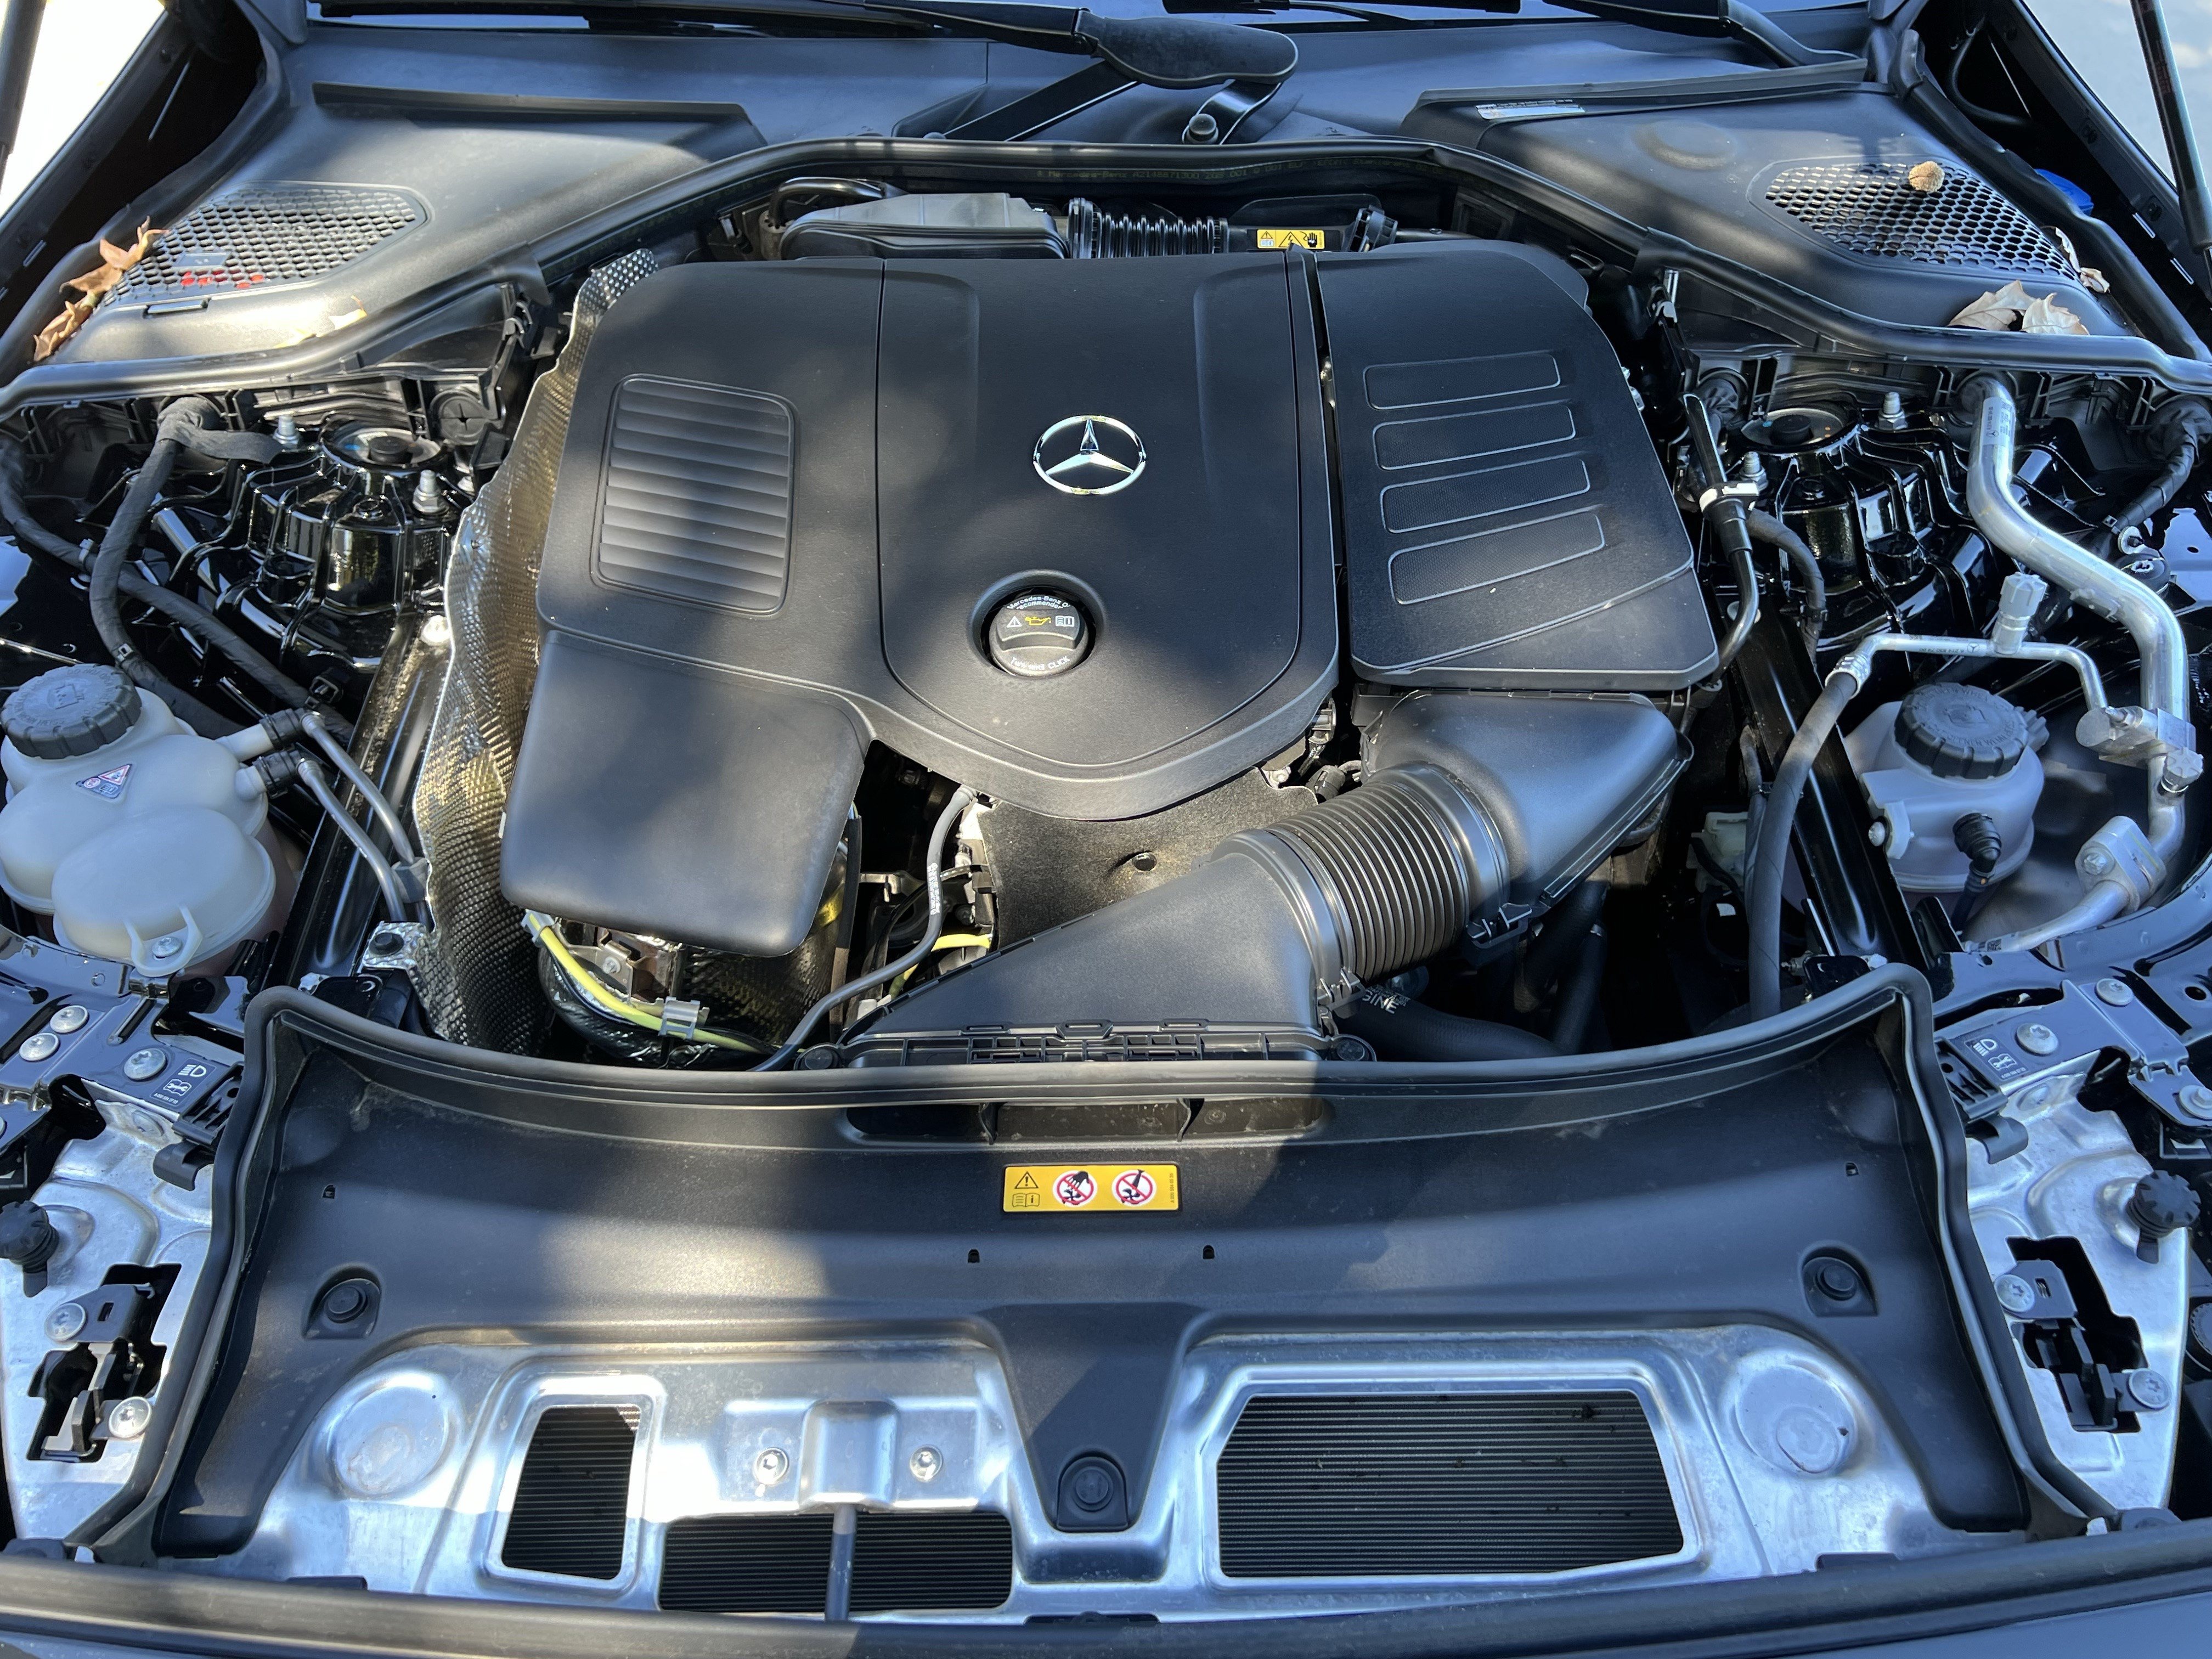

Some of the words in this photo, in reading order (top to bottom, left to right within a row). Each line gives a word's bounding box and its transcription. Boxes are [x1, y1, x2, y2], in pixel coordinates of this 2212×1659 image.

[1007, 596, 1062, 609] Mercedes-Benz
[1010, 657, 1027, 669] Turn
[1047, 655, 1071, 669] CLICK
